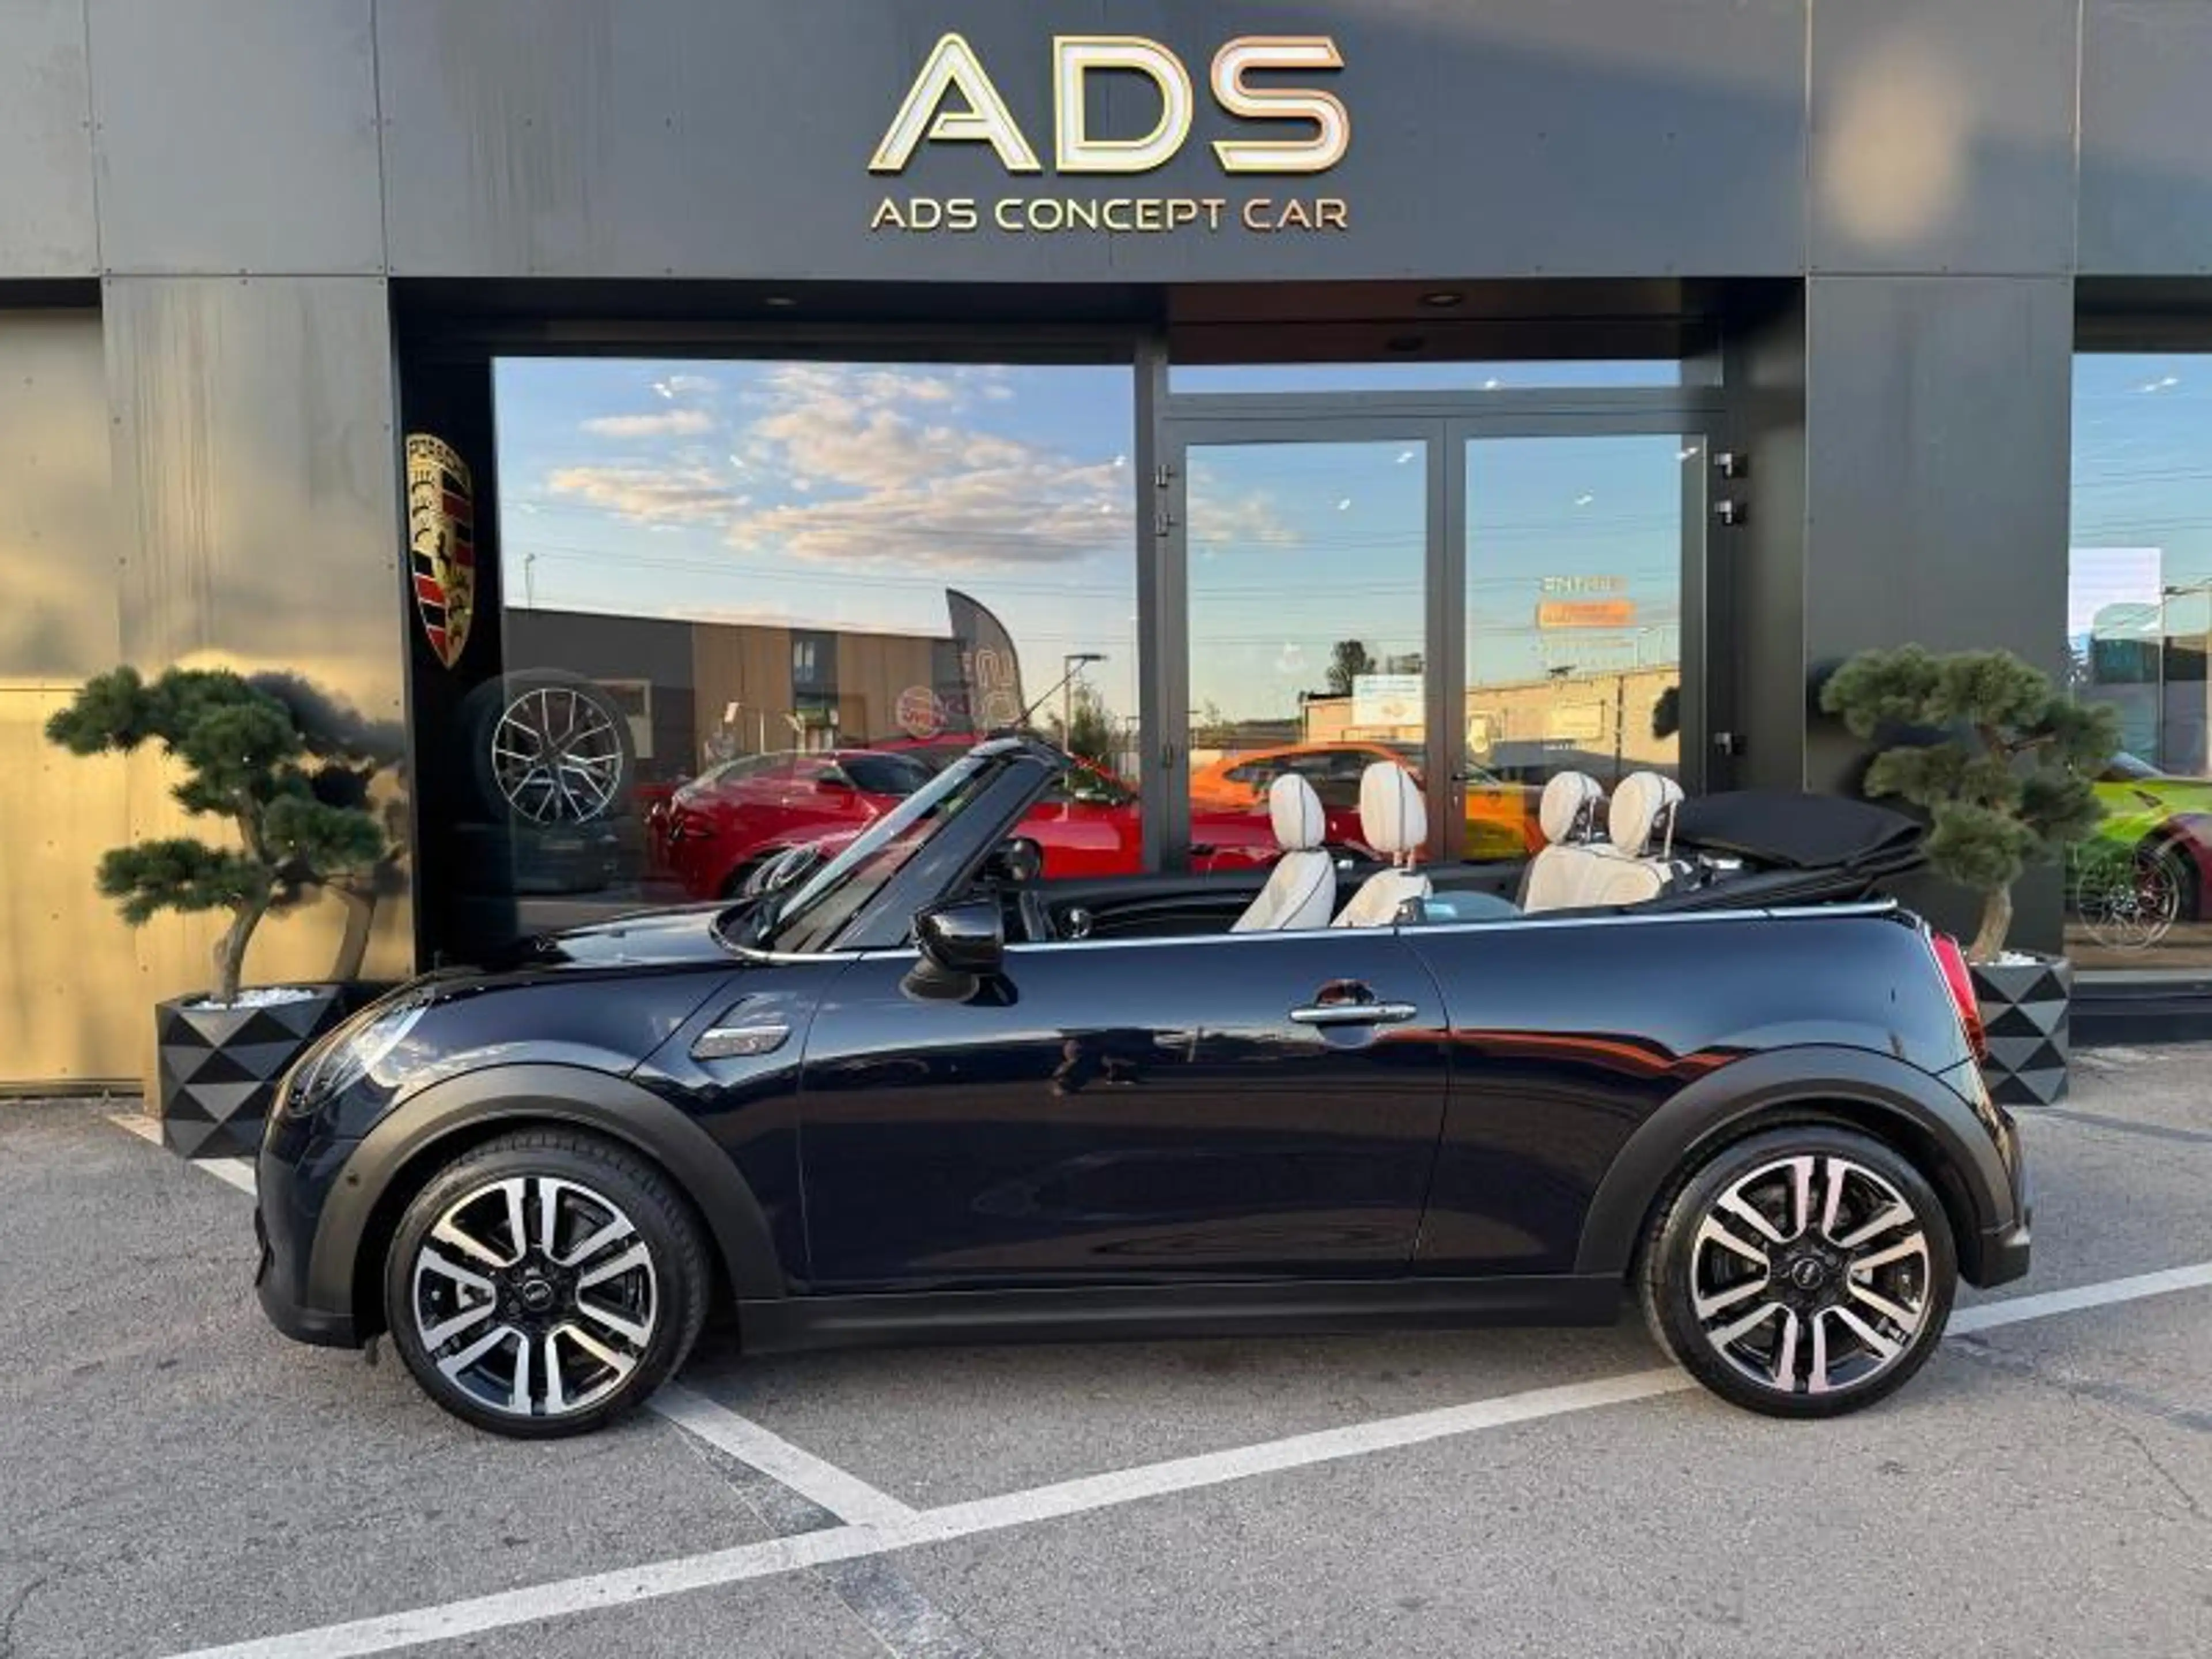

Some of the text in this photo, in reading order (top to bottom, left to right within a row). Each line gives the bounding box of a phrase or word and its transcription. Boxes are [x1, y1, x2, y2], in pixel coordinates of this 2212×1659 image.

[868, 33, 1351, 174] ADS
[870, 196, 1349, 229] ADS CONCEPT CAR
